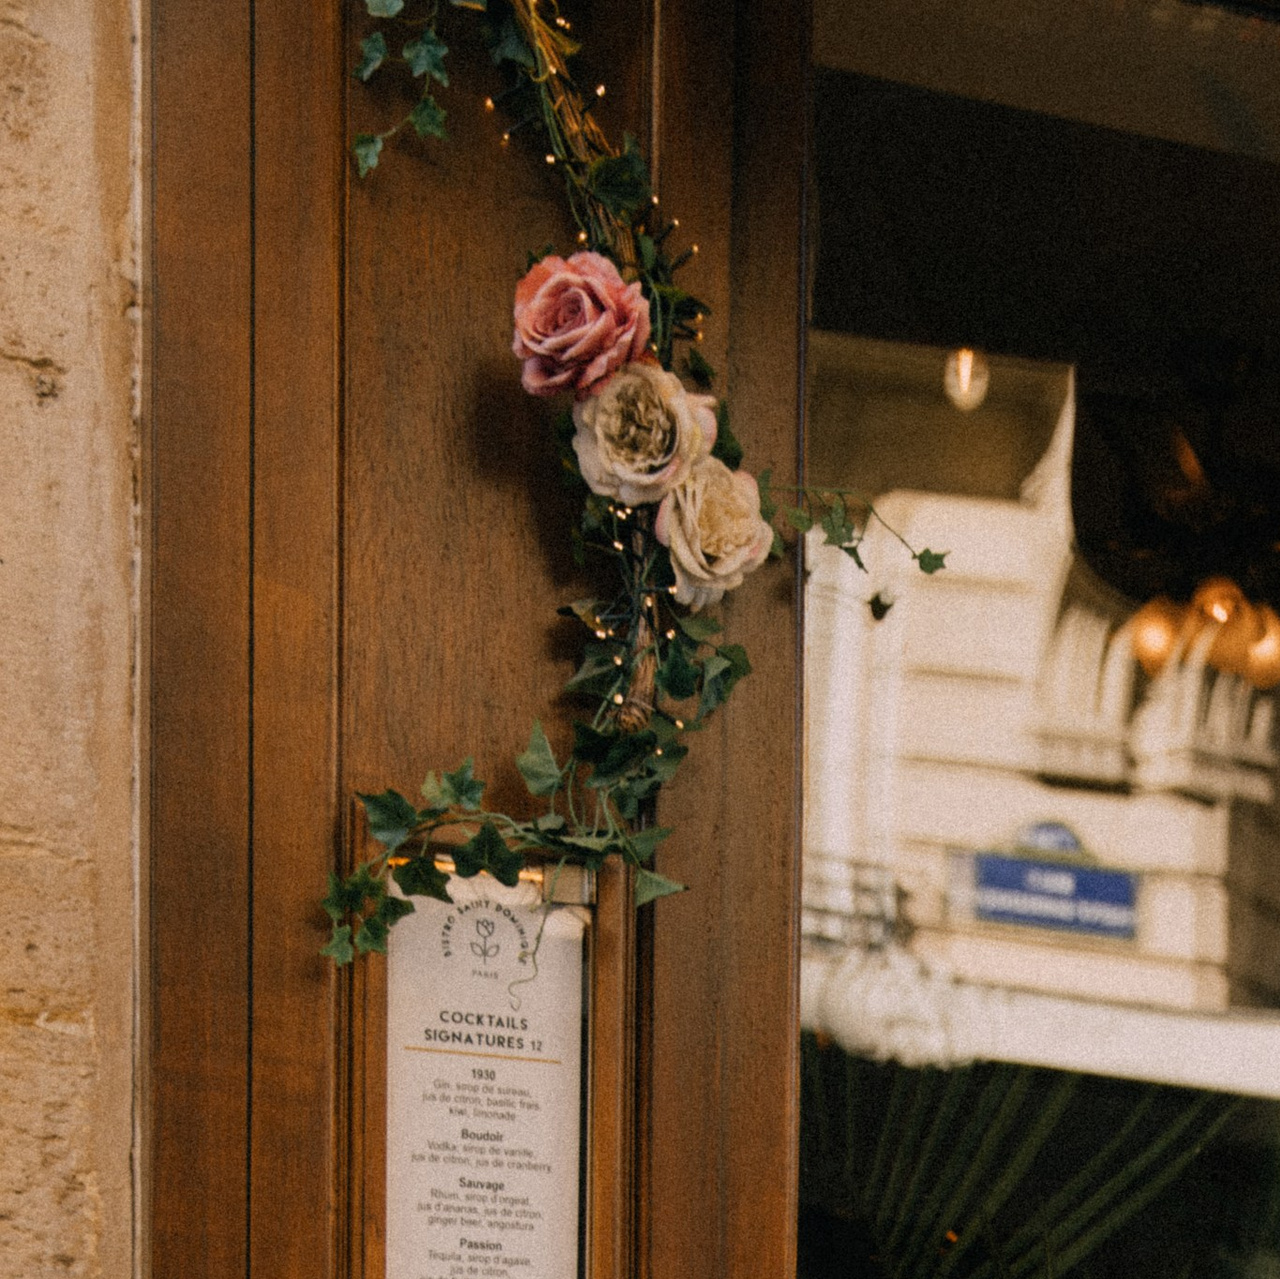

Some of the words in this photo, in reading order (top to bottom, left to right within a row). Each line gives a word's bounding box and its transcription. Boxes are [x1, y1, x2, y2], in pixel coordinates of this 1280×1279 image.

[441, 913, 456, 958] BISTRO
[456, 899, 491, 915] SAINT
[494, 903, 529, 966] DOMINIQE
[472, 969, 499, 979] PARIS
[439, 1010, 529, 1030] COCKTAILS
[424, 1028, 525, 1050] SIGNATURES
[530, 1039, 543, 1051] 12
[471, 1068, 495, 1080] 1930
[461, 1128, 503, 1142] Boudoir
[459, 1176, 504, 1193] Sauvage
[459, 1238, 502, 1251] Passion
